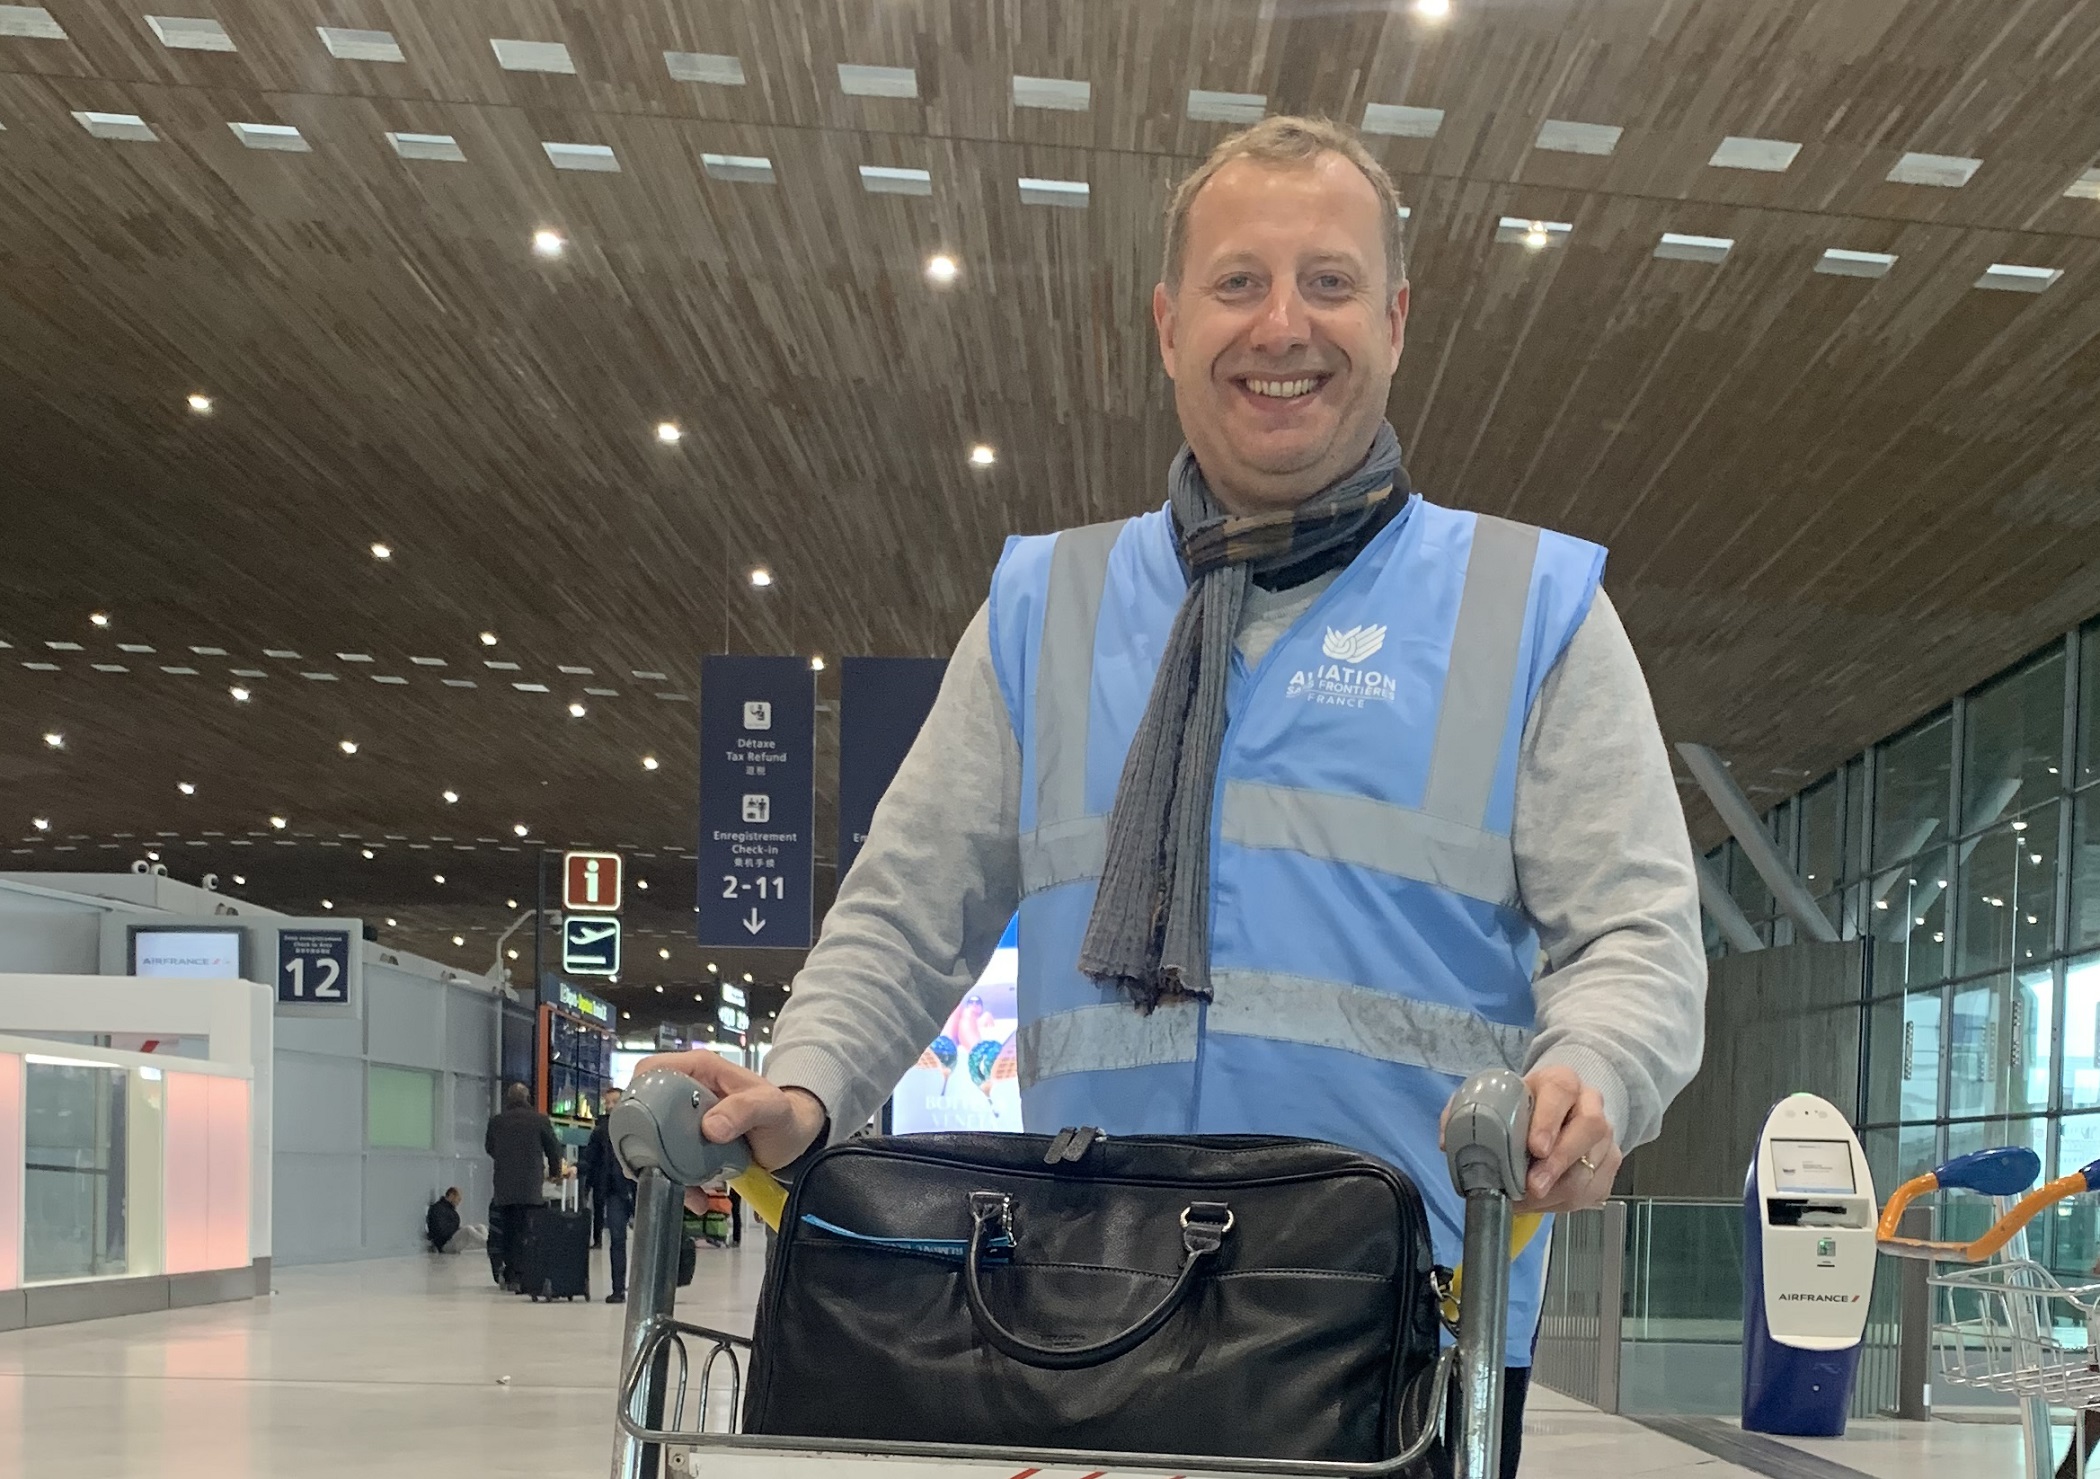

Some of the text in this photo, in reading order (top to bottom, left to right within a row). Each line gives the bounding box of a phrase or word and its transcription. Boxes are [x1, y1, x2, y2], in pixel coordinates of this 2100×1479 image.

[1289, 664, 1396, 692] AIATION
[1307, 692, 1365, 708] FRANCE
[737, 738, 776, 749] Détaxe
[726, 751, 787, 763] Tax Refund
[713, 831, 797, 844] Enregistrement
[731, 844, 779, 855] Check-in
[722, 875, 785, 900] 2-11
[285, 958, 341, 997] 12
[1778, 1293, 1848, 1303] AIRFRANCE
